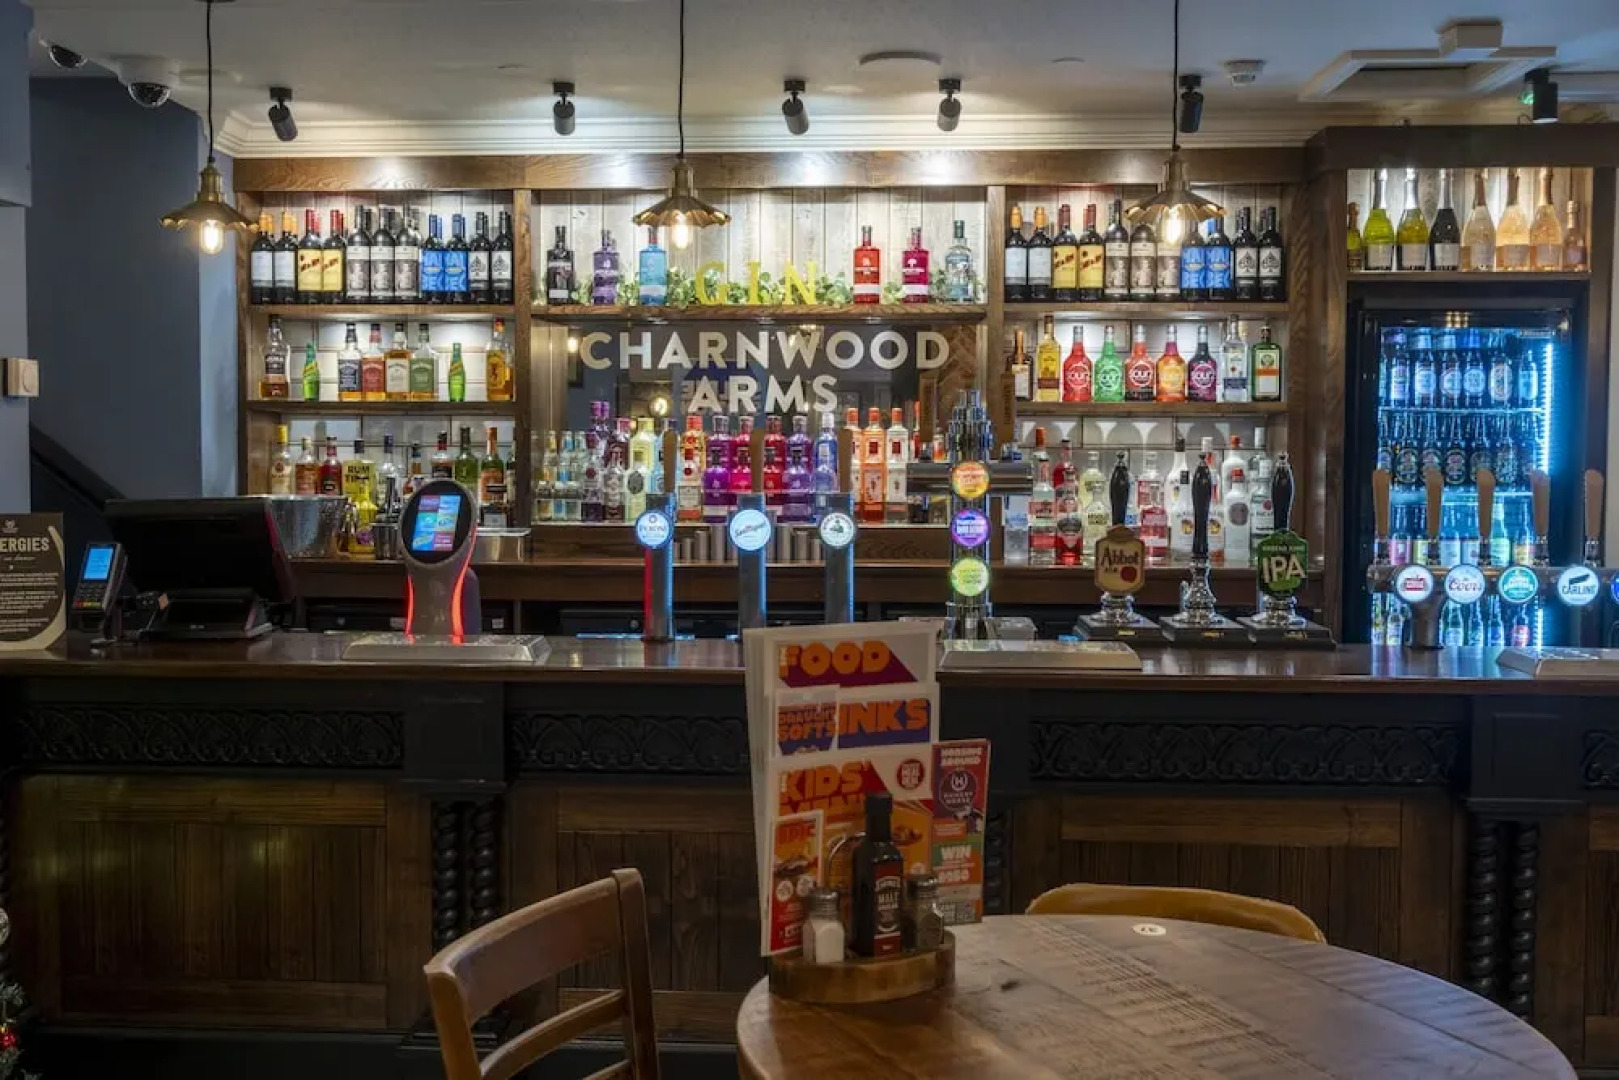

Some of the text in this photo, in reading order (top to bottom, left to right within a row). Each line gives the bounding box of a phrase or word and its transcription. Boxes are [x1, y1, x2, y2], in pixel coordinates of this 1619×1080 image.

[695, 261, 817, 306] GIN
[580, 330, 951, 370] CHARNWOOD
[687, 374, 838, 414] ARMS
[347, 465, 370, 474] RUM
[0, 536, 49, 552] ERGIES
[1101, 545, 1139, 567] Abbot
[1262, 553, 1306, 584] IPA
[779, 640, 891, 679] FOOD
